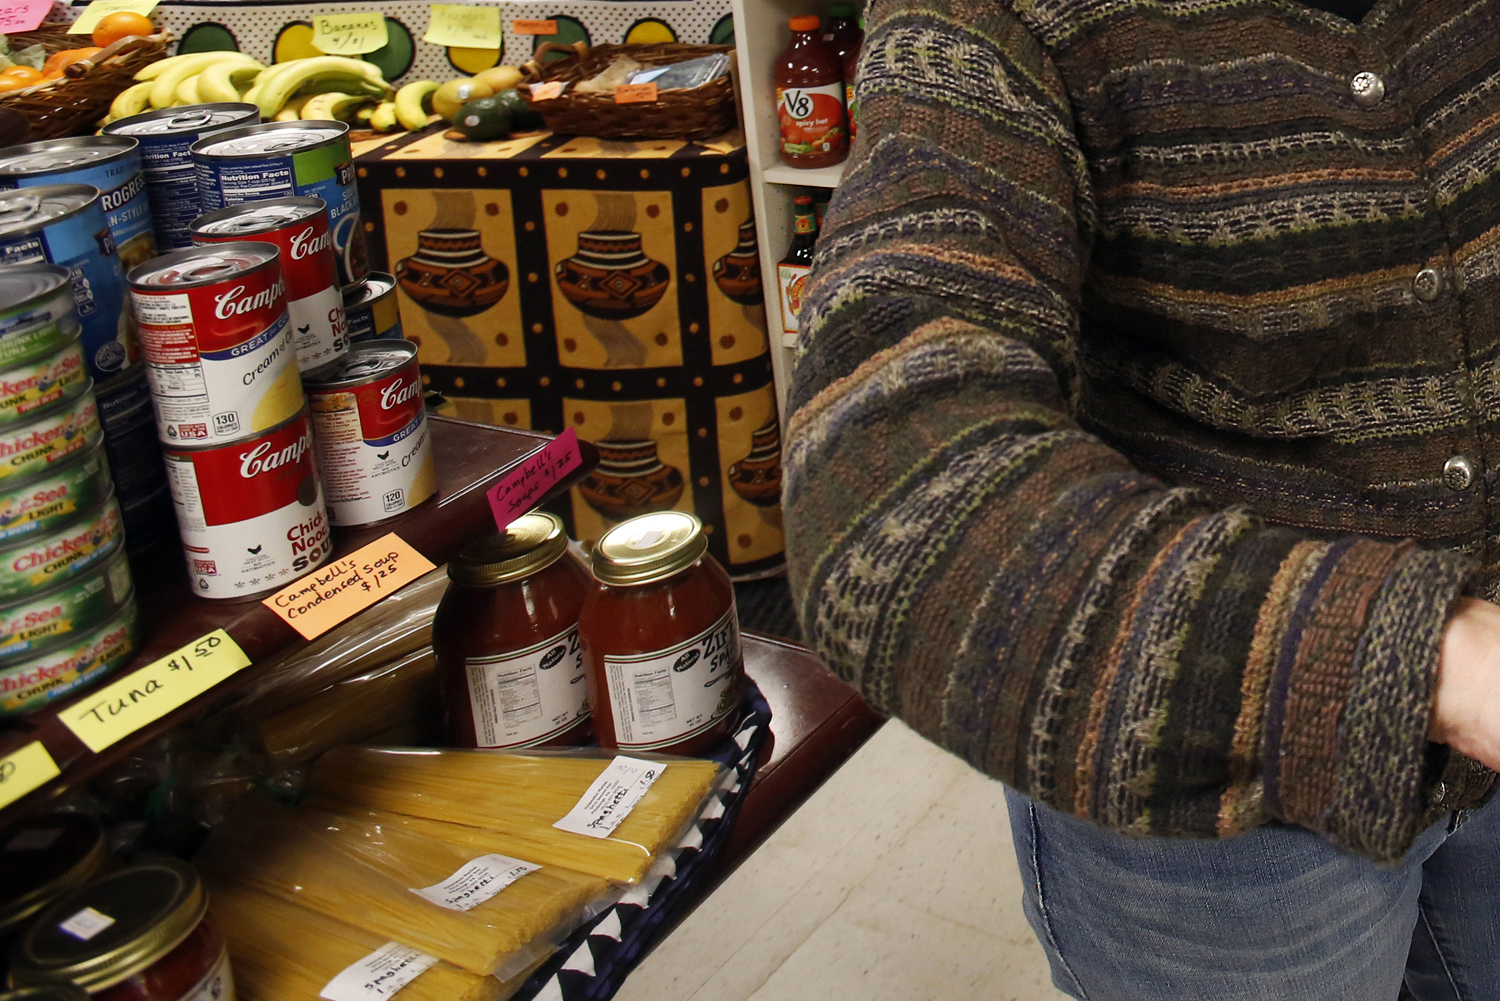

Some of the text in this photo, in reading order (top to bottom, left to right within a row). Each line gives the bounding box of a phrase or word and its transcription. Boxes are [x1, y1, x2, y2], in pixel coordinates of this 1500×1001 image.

[321, 17, 379, 33] Bananas
[783, 89, 811, 116] V8
[219, 169, 291, 182] Nutrition Facts
[230, 334, 270, 356] GREAT
[214, 413, 236, 425] 130
[179, 427, 208, 437] USA
[384, 491, 402, 502] 120
[274, 560, 358, 608] Campbell's
[287, 570, 364, 619] Condensed
[18, 620, 62, 637] LIGHT
[77, 680, 165, 723] Tuna
